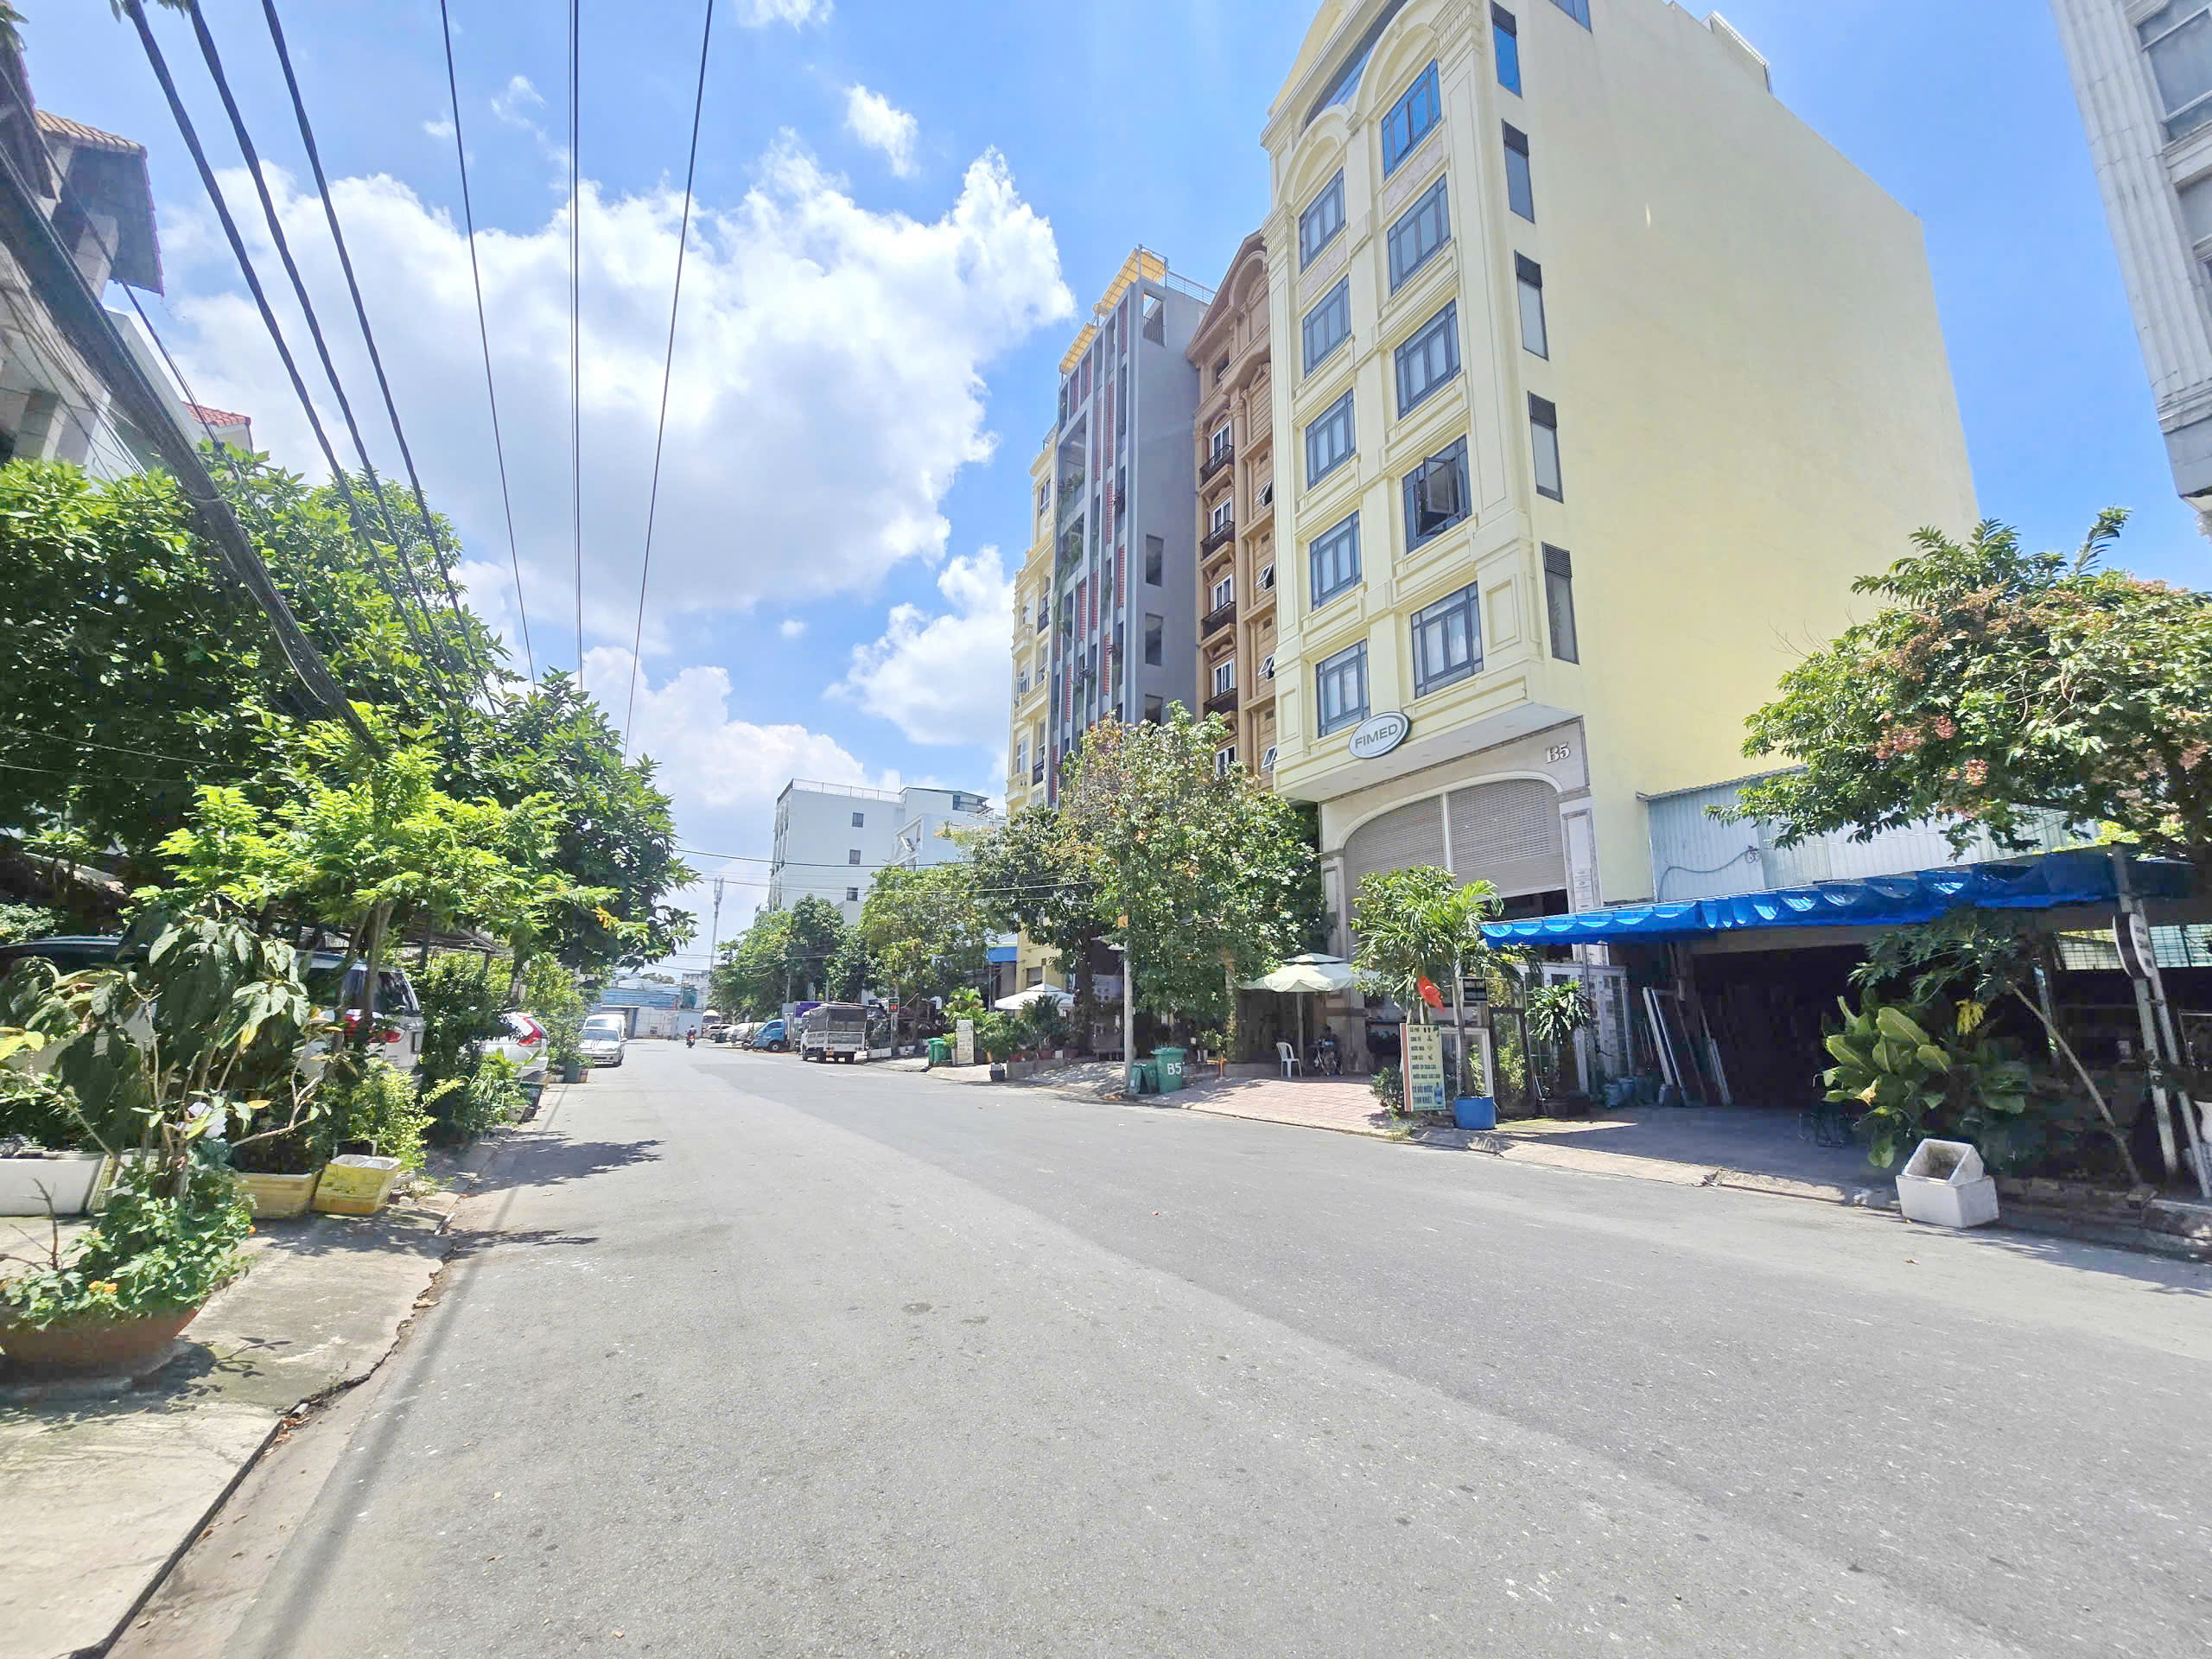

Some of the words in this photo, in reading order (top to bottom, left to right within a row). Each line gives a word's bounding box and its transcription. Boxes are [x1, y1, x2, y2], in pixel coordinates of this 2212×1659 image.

[1355, 724, 1398, 749] FIMED
[1546, 741, 1570, 764] B5
[1167, 1062, 1182, 1076] B5
